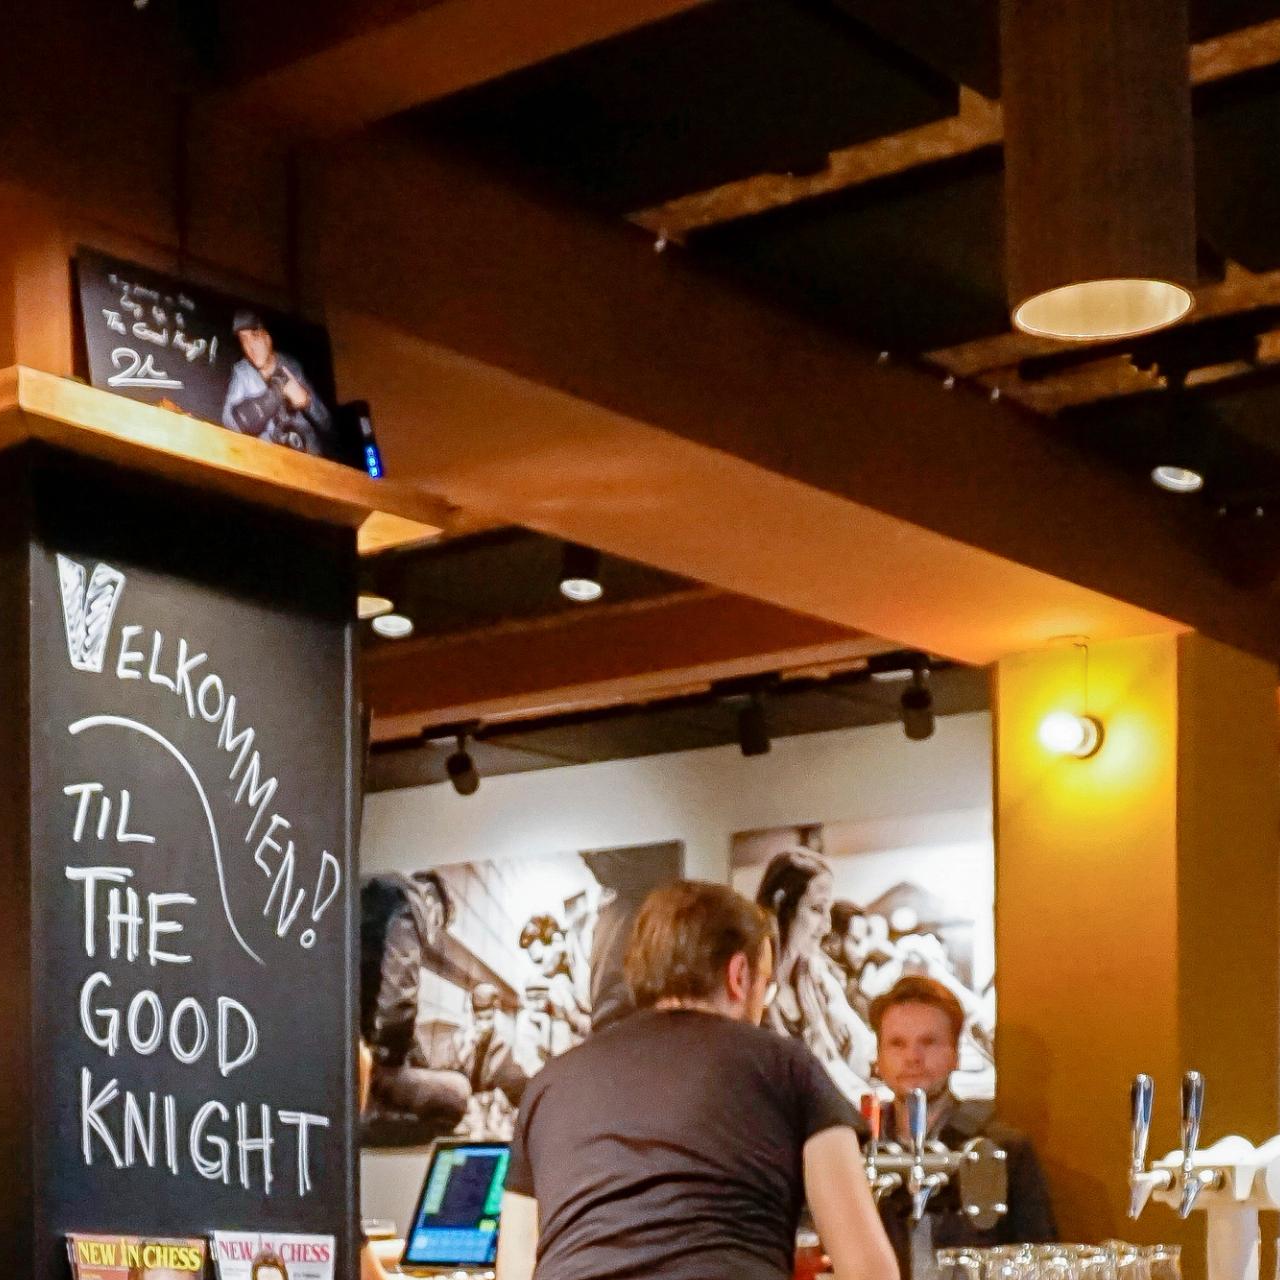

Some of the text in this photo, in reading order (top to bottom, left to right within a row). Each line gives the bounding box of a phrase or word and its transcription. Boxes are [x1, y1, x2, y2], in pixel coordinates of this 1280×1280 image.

[56, 554, 341, 949] VELKOMMEN!
[64, 782, 155, 844] TIL
[65, 866, 196, 964] THE
[80, 971, 258, 1077] GOOD
[81, 1065, 329, 1196] KNIGHT
[77, 1237, 201, 1272] NEW IN CHESS
[219, 1240, 253, 1261] NEW
[279, 1242, 330, 1263] CHESS
